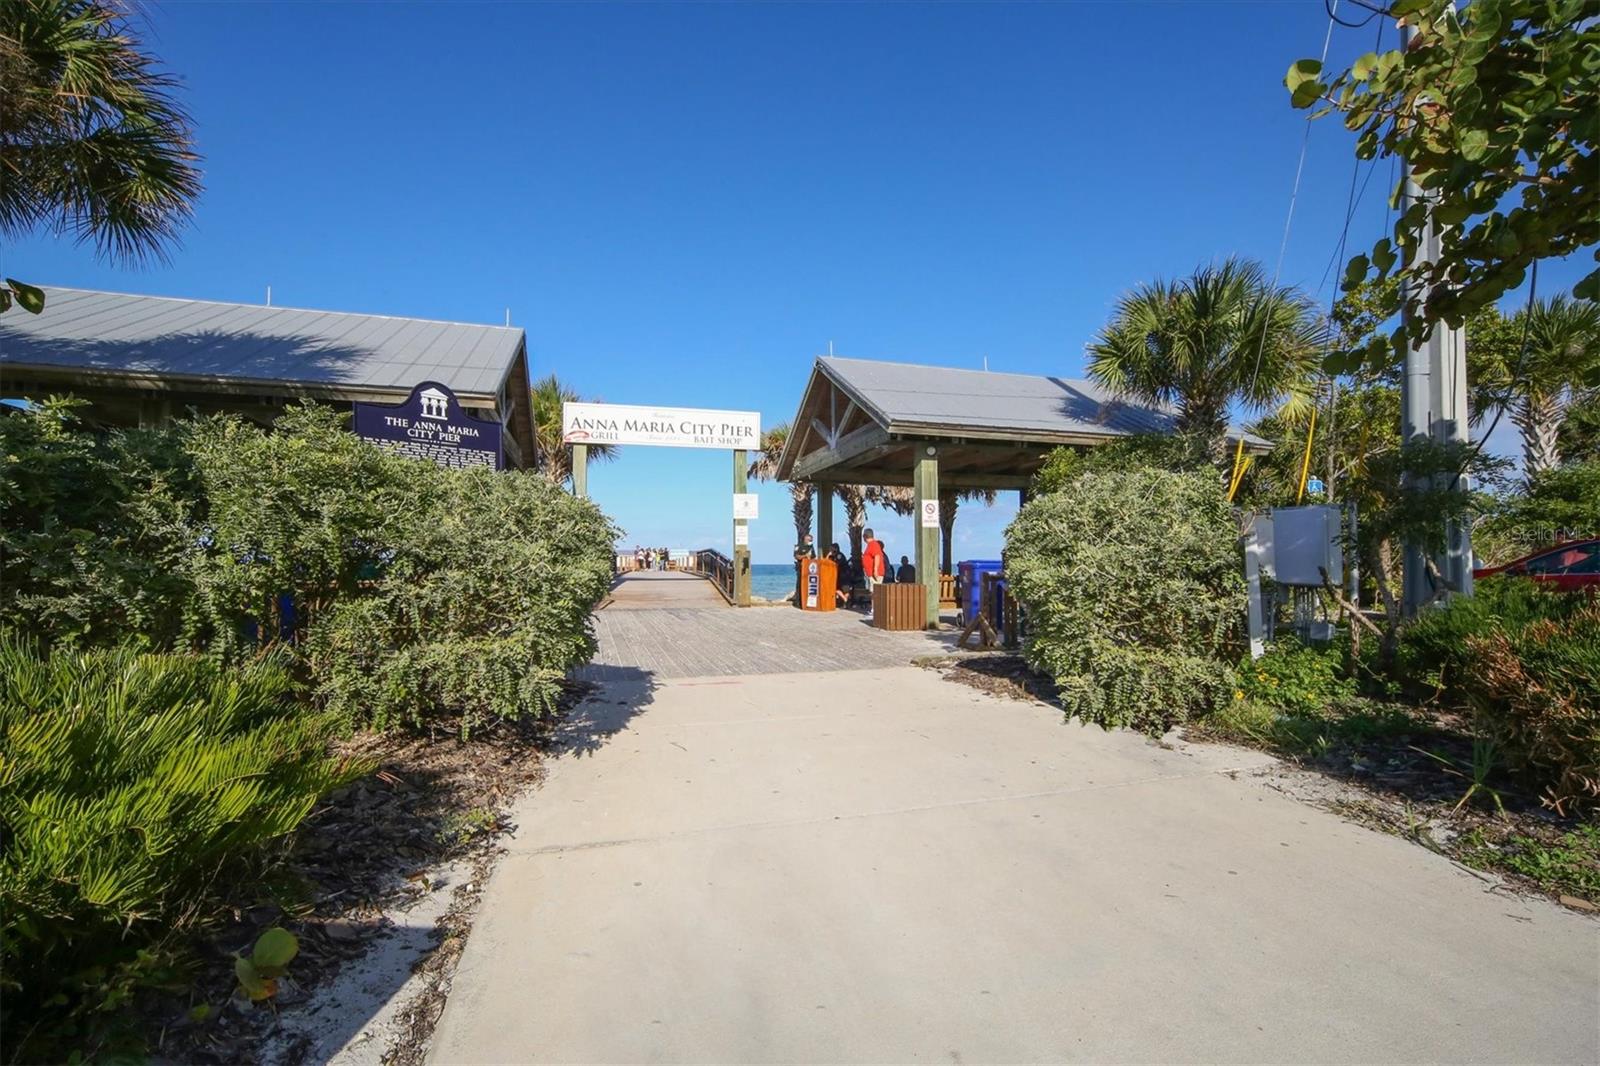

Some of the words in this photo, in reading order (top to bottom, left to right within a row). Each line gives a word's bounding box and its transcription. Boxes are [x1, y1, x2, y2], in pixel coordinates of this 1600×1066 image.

[385, 416, 408, 428] THE
[414, 421, 443, 432] ANNA
[448, 425, 480, 437] MARIA
[571, 416, 619, 431] ANNA
[624, 419, 675, 434] MARIA
[680, 421, 716, 435] CITY
[721, 423, 754, 437] PIER
[407, 428, 434, 439] CITY
[439, 432, 461, 443] PIER
[591, 431, 619, 440] GRILL
[694, 436, 714, 444] BAIT
[718, 437, 742, 446] SHOP
